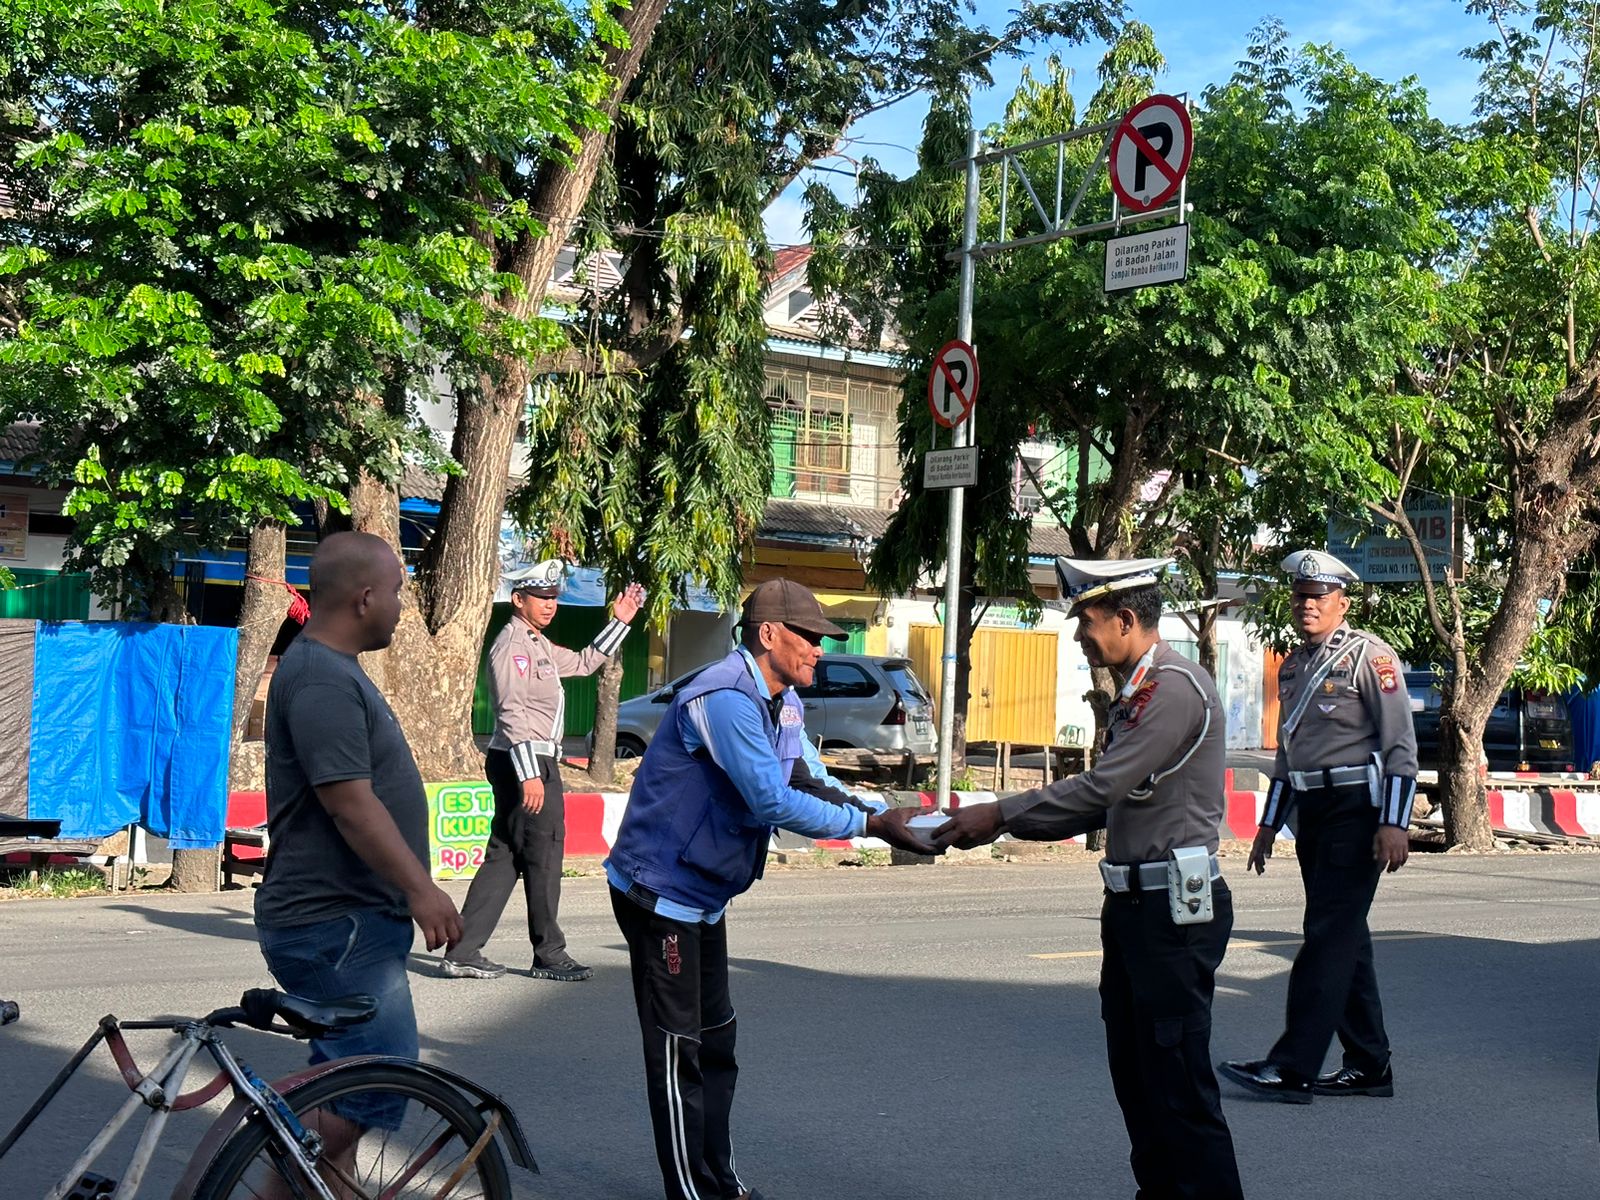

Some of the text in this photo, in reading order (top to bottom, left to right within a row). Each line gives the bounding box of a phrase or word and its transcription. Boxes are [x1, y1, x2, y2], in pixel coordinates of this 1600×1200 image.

[1134, 121, 1173, 192] P
[1115, 236, 1177, 257] Dilarang Parkir
[1115, 250, 1176, 268] di Badan Jalan
[1111, 261, 1179, 280] Sampai Rambu Berikutnya
[943, 360, 968, 413] P
[930, 453, 971, 464] Dilarang Parkir
[937, 464, 953, 472] Badan
[954, 462, 970, 471] Jalan
[1408, 516, 1447, 540] MB
[1368, 563, 1388, 574] PERDA
[1388, 563, 1400, 574] NO.
[1401, 563, 1409, 573] 11
[442, 790, 495, 813] ES T
[441, 815, 491, 838] KUR
[441, 847, 484, 871] Rp 2
